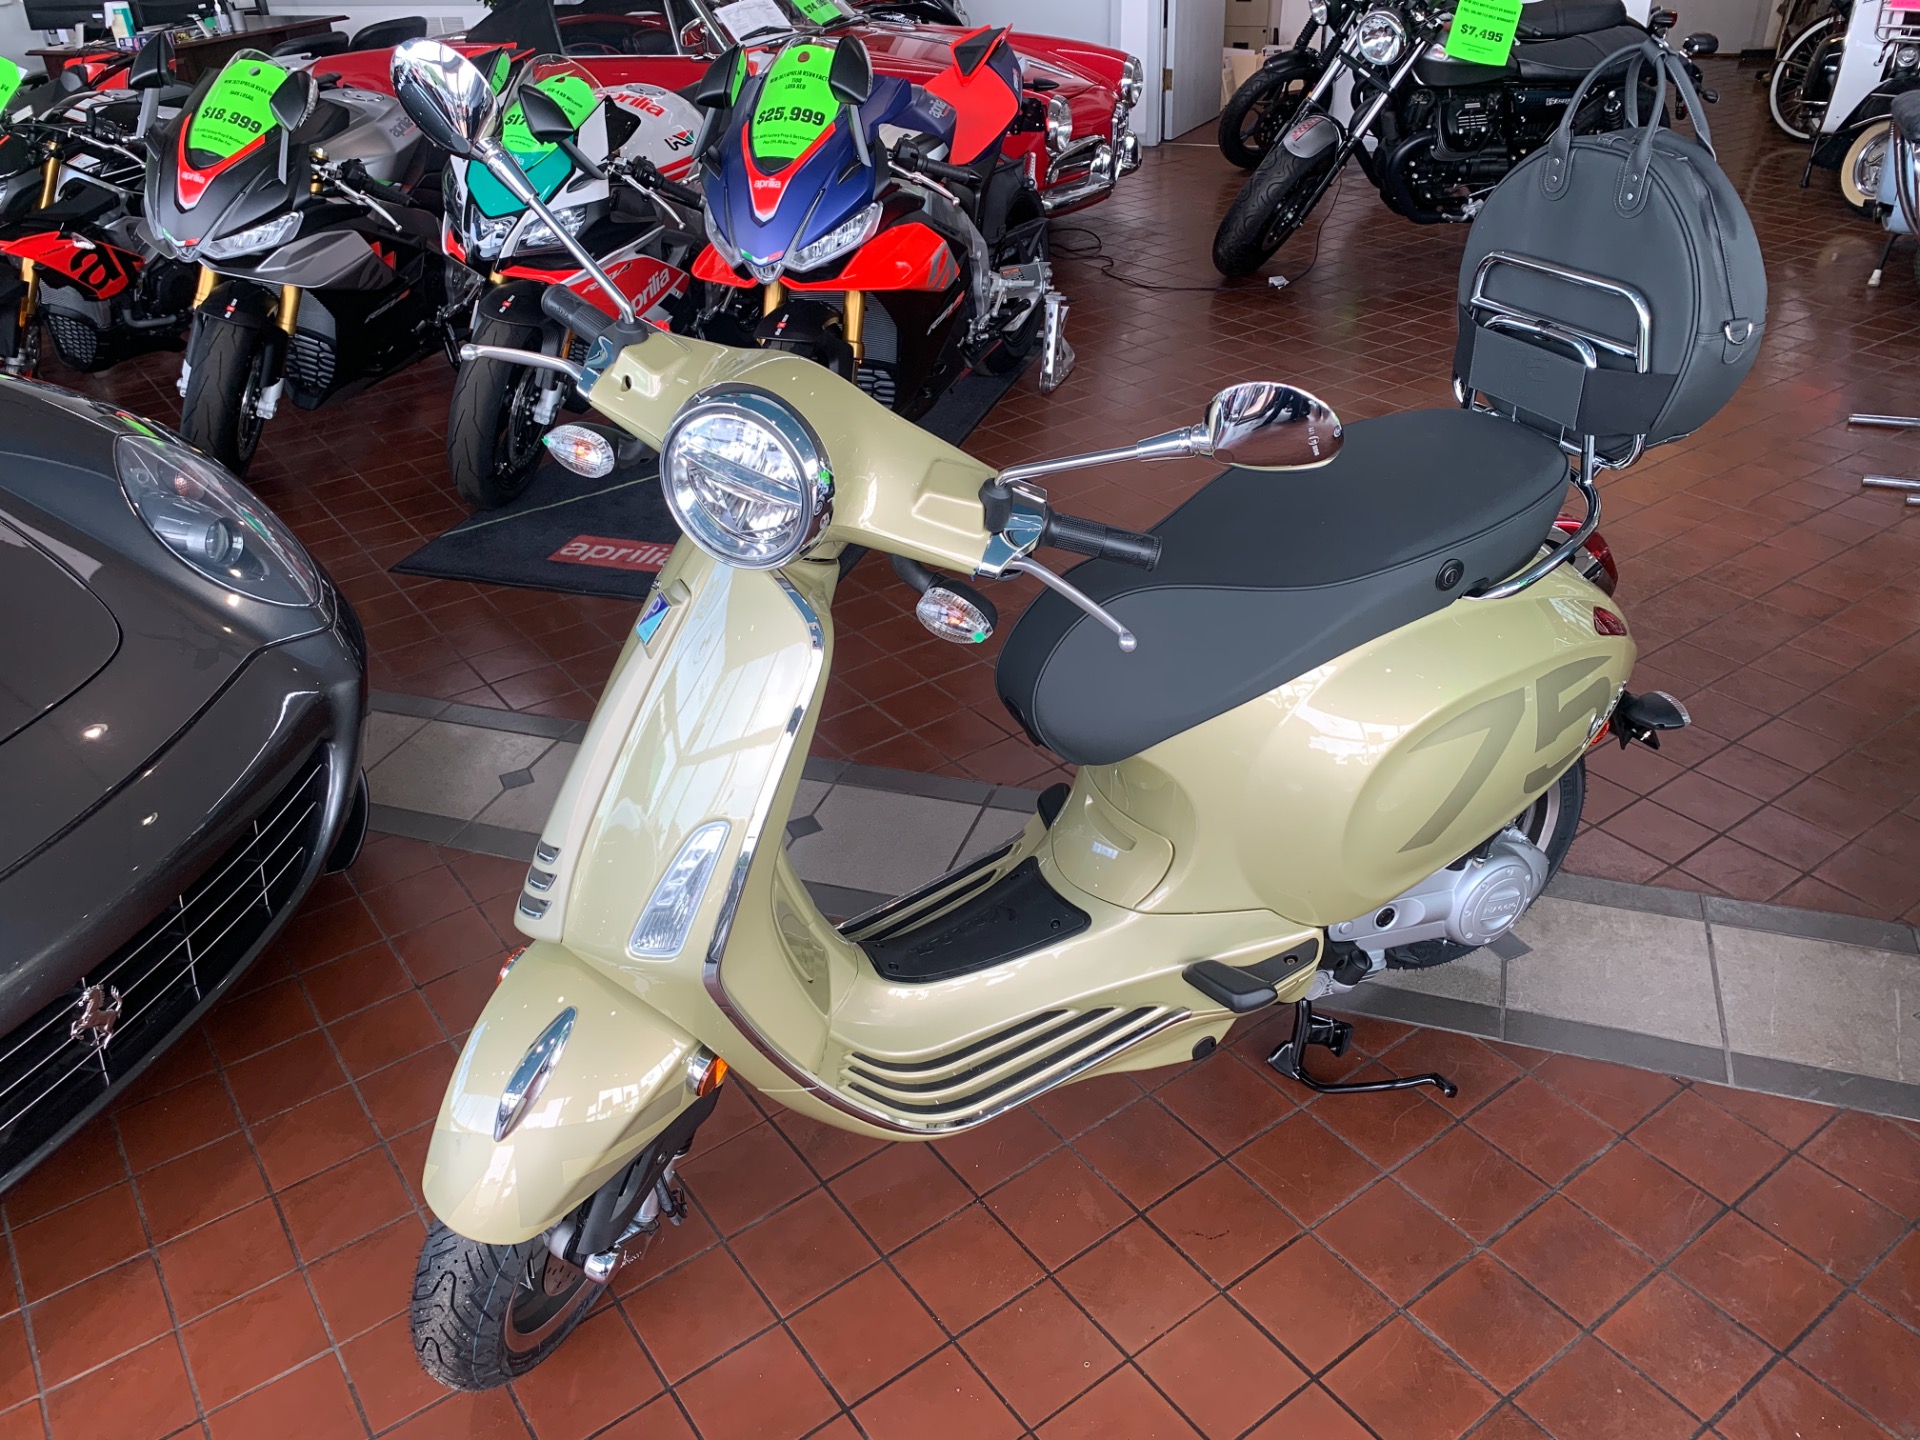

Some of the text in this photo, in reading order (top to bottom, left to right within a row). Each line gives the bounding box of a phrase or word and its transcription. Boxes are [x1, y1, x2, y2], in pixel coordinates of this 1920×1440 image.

[1460, 23, 1504, 43] $7,495
[202, 106, 263, 134] $18,999
[756, 106, 826, 127] $25,999
[181, 172, 205, 184] aprilia
[754, 178, 781, 189] aprilia
[626, 268, 670, 314] prilia
[1398, 655, 1612, 853] 75
